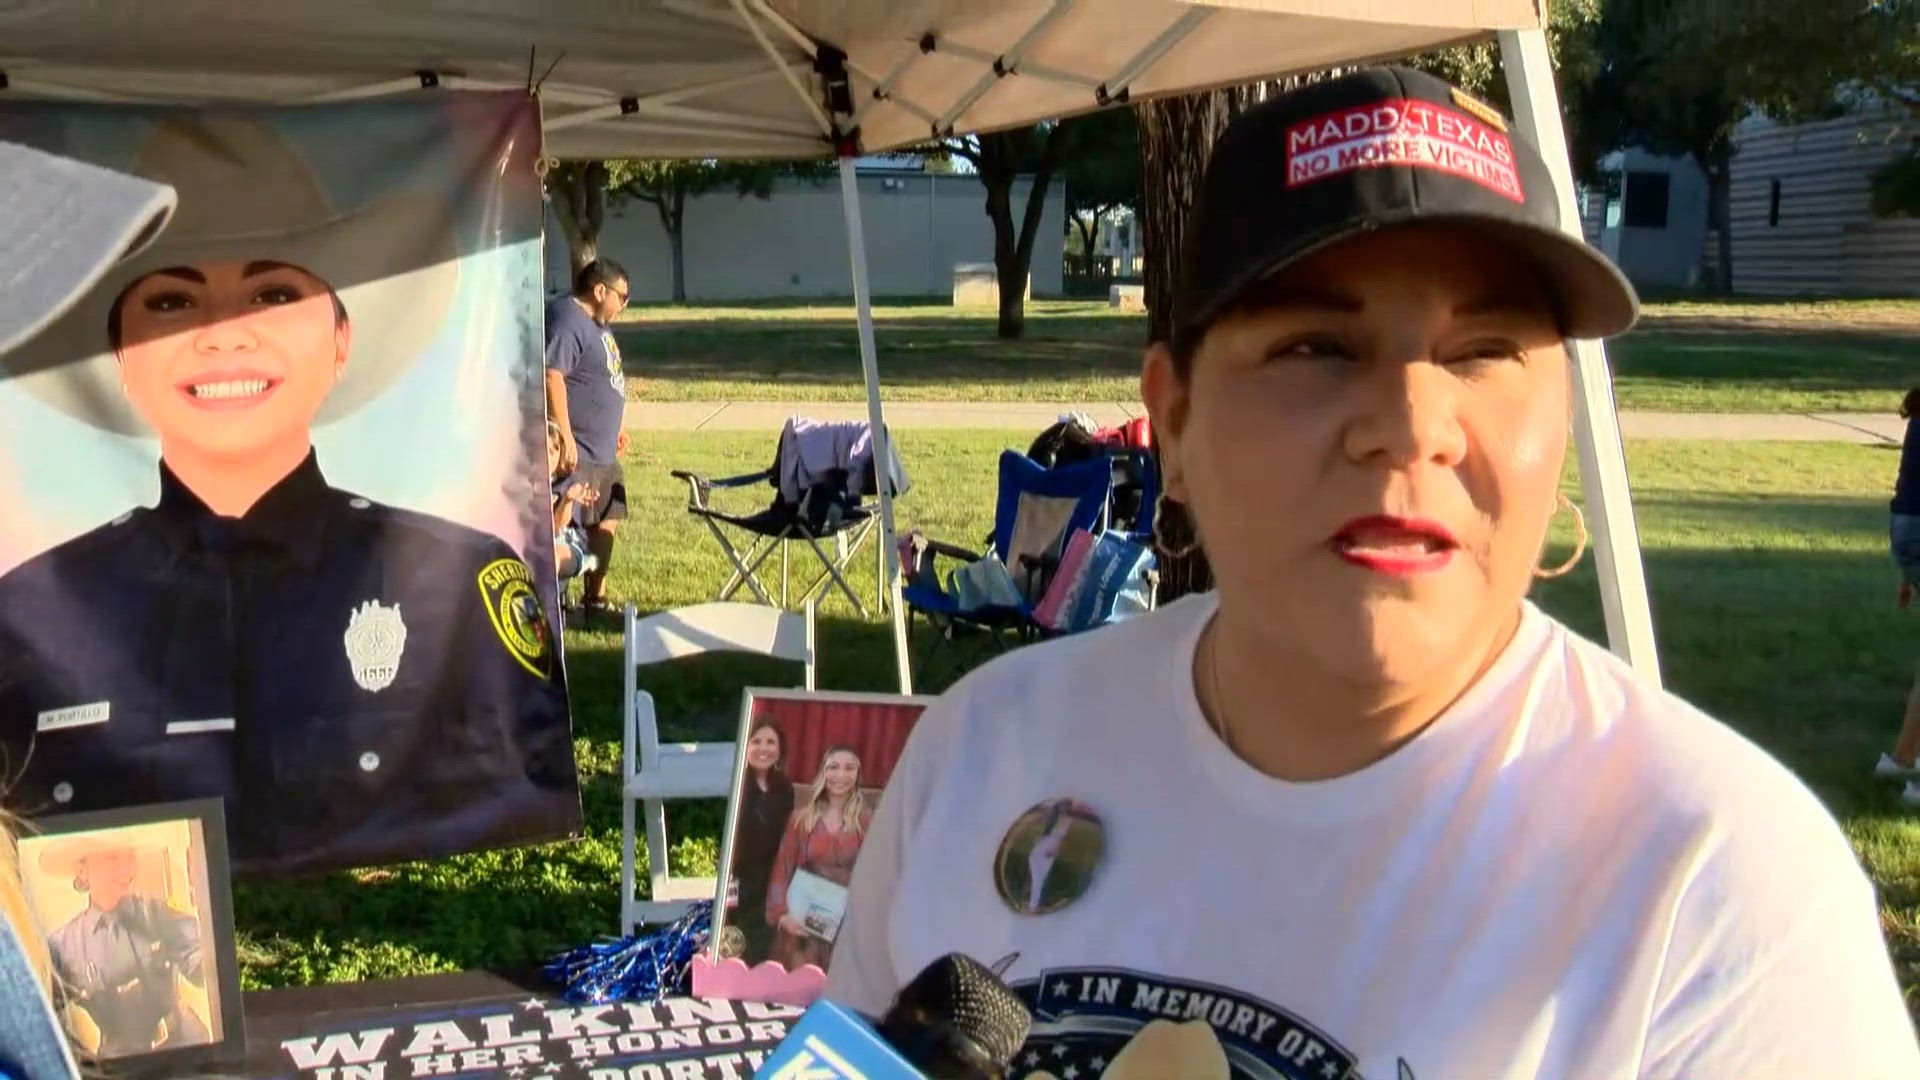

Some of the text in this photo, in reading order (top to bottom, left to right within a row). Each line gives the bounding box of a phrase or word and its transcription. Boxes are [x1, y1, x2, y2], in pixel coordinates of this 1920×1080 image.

[1293, 156, 1331, 182] NO
[1337, 139, 1421, 169] MORE
[1410, 108, 1511, 165] TEXAS
[410, 1043, 544, 1077] HER
[567, 1020, 786, 1059] HONOR
[1077, 976, 1327, 1067] IN MEMORY OF
